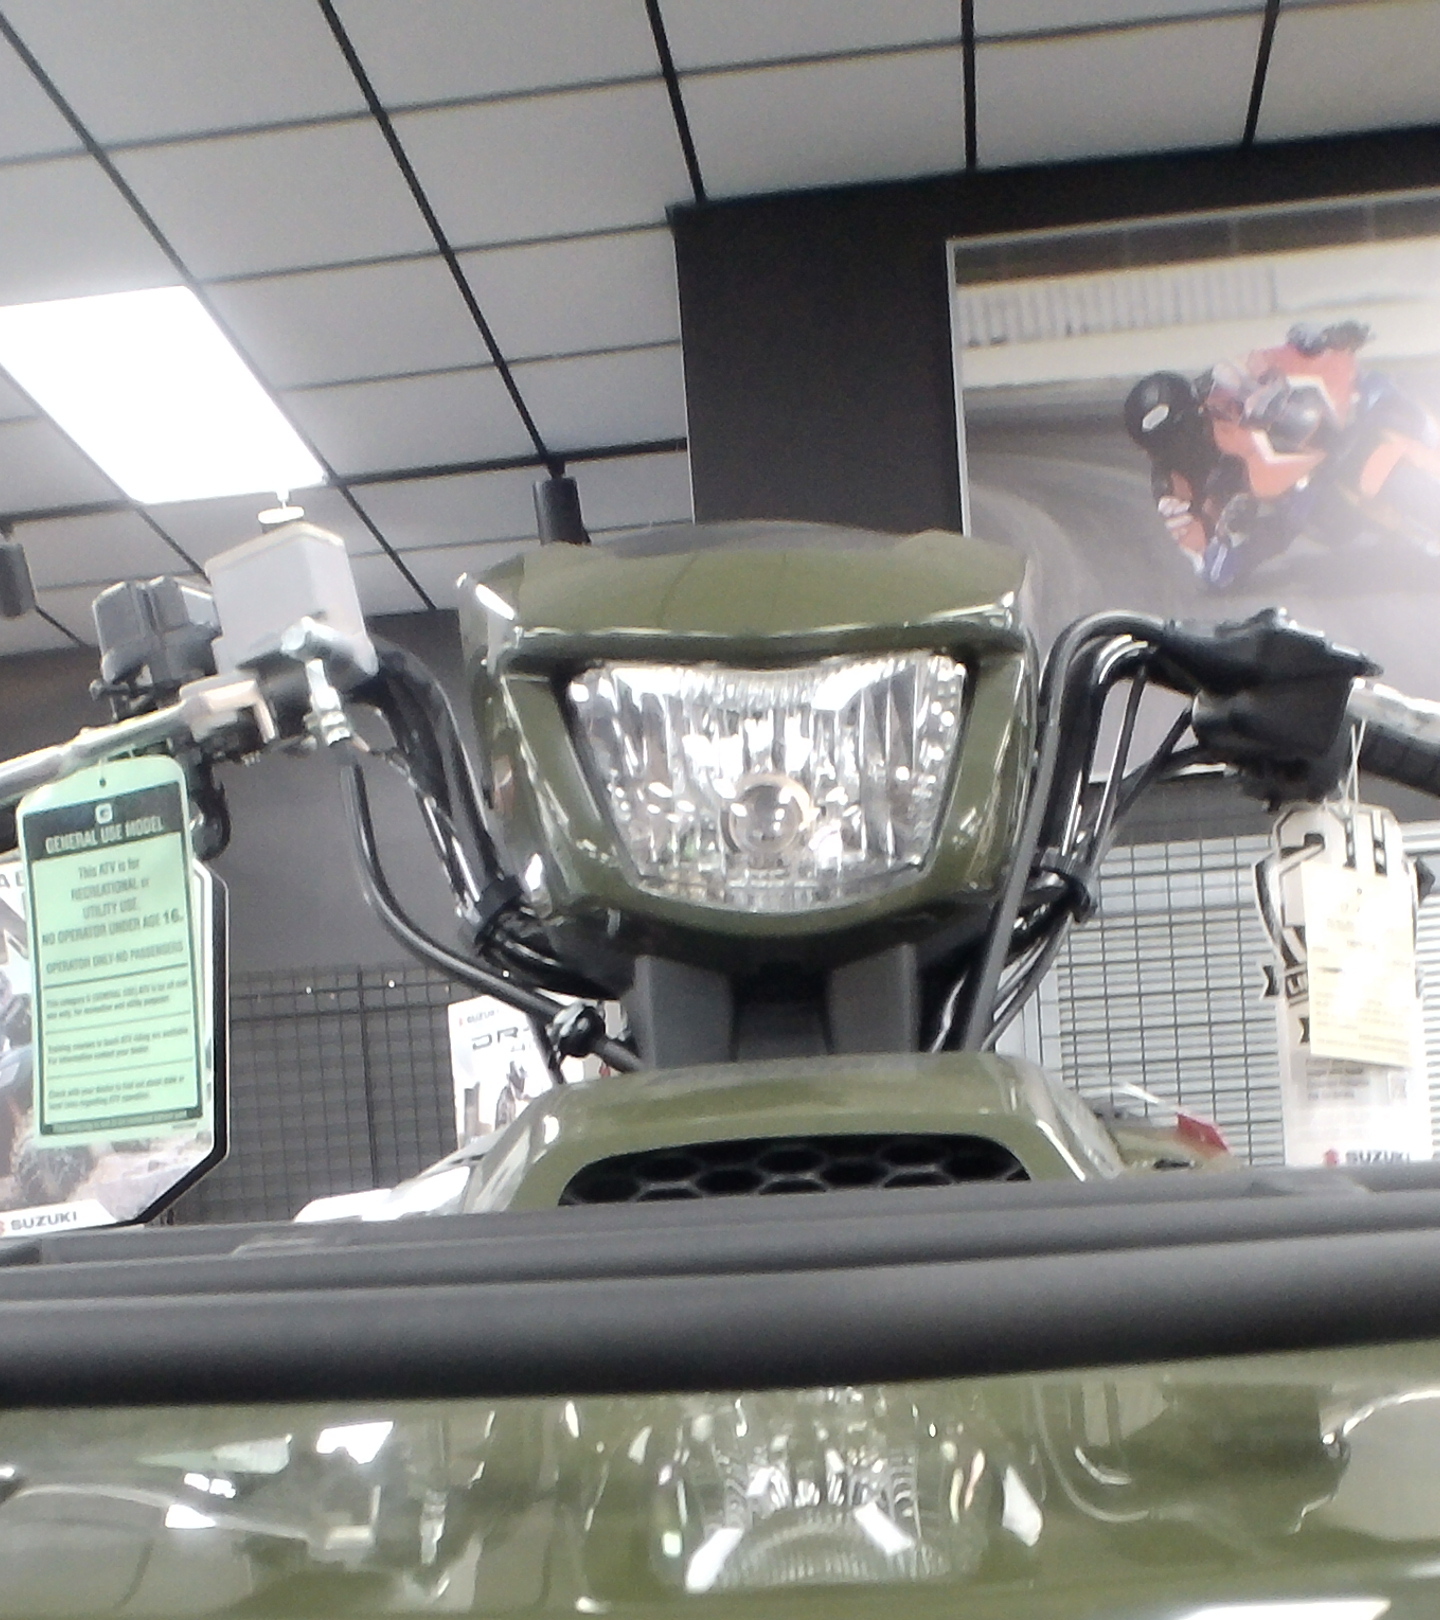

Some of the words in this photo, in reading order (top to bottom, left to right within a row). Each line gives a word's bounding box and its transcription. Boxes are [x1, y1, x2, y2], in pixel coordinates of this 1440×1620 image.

[45, 830, 98, 854] GENERAL
[100, 823, 123, 844] USE
[125, 815, 164, 838] MODEL
[11, 1211, 77, 1231] SUZUKI
